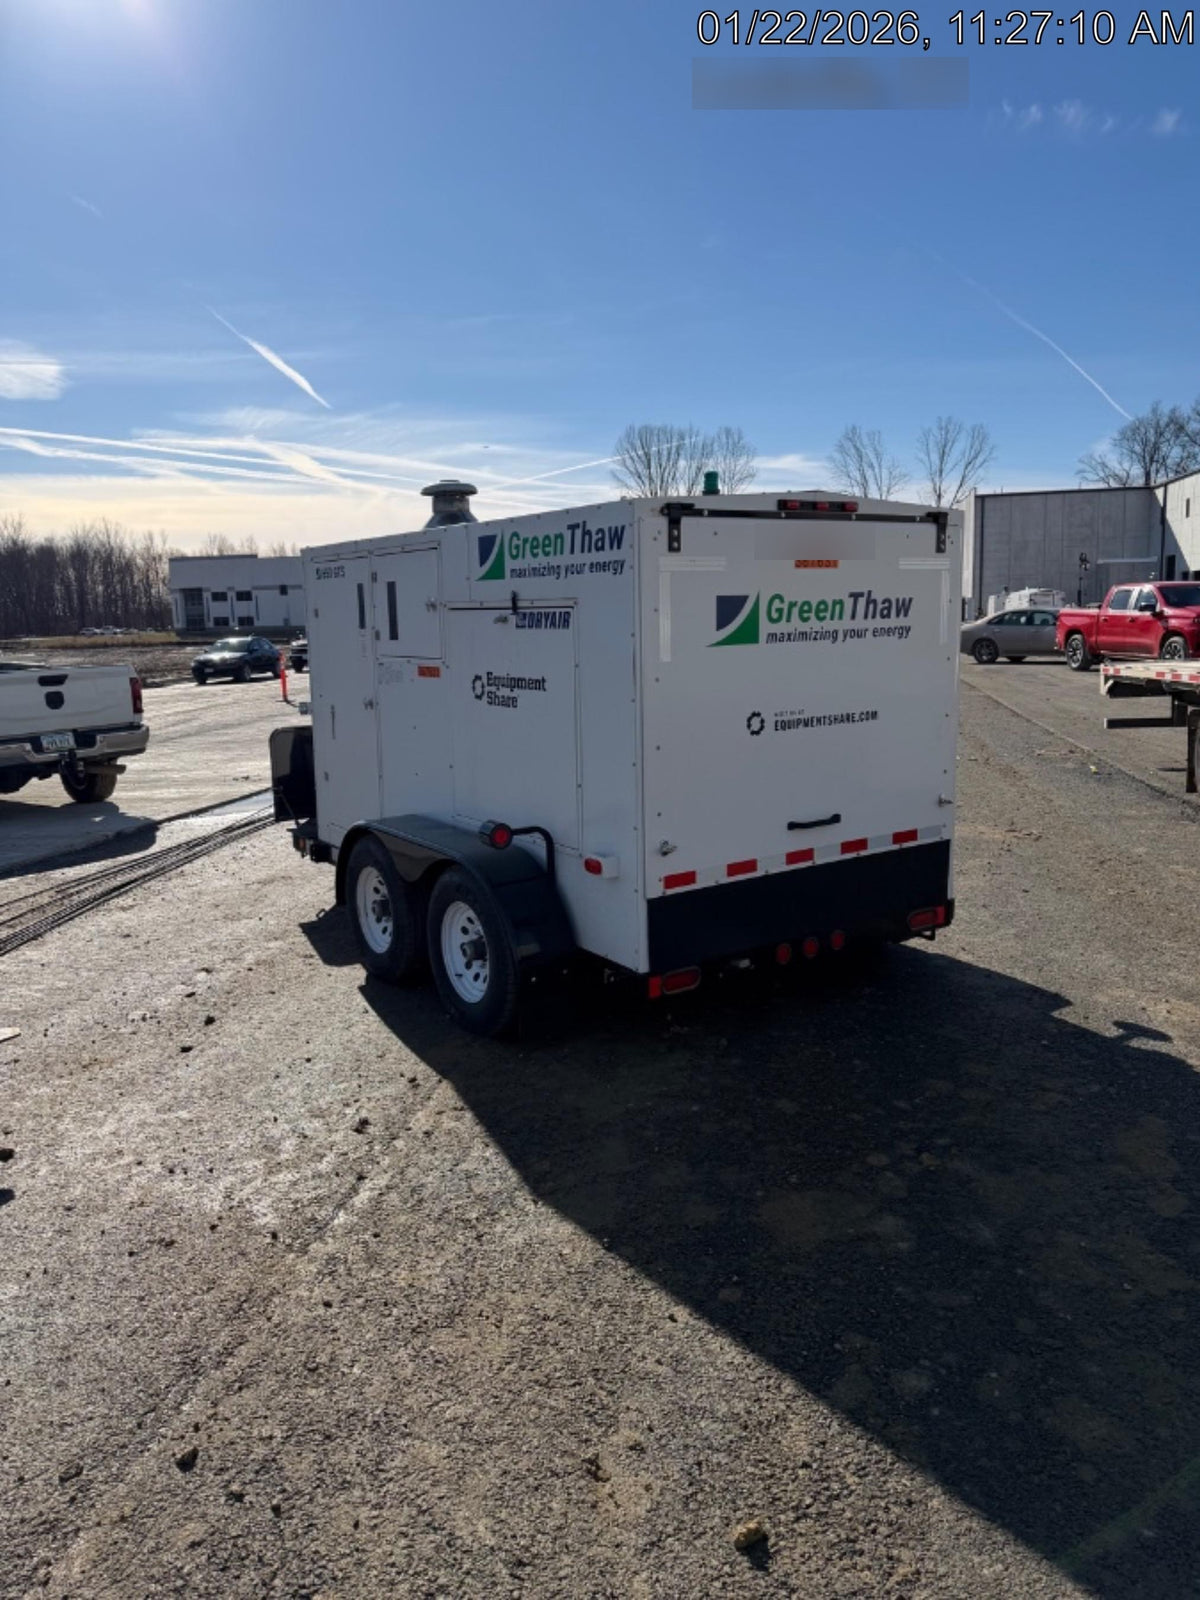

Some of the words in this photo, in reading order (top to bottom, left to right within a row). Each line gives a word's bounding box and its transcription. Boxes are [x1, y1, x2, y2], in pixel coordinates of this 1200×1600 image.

[510, 562, 561, 580] maximizing
[564, 562, 587, 579] your
[589, 559, 626, 576] energy
[766, 626, 840, 644] maximizing
[842, 627, 869, 643] your
[872, 625, 912, 639] energy
[486, 671, 547, 692] Equipment
[486, 690, 518, 708] Share
[774, 710, 878, 732] EQUIPMENTSHARE.COM
